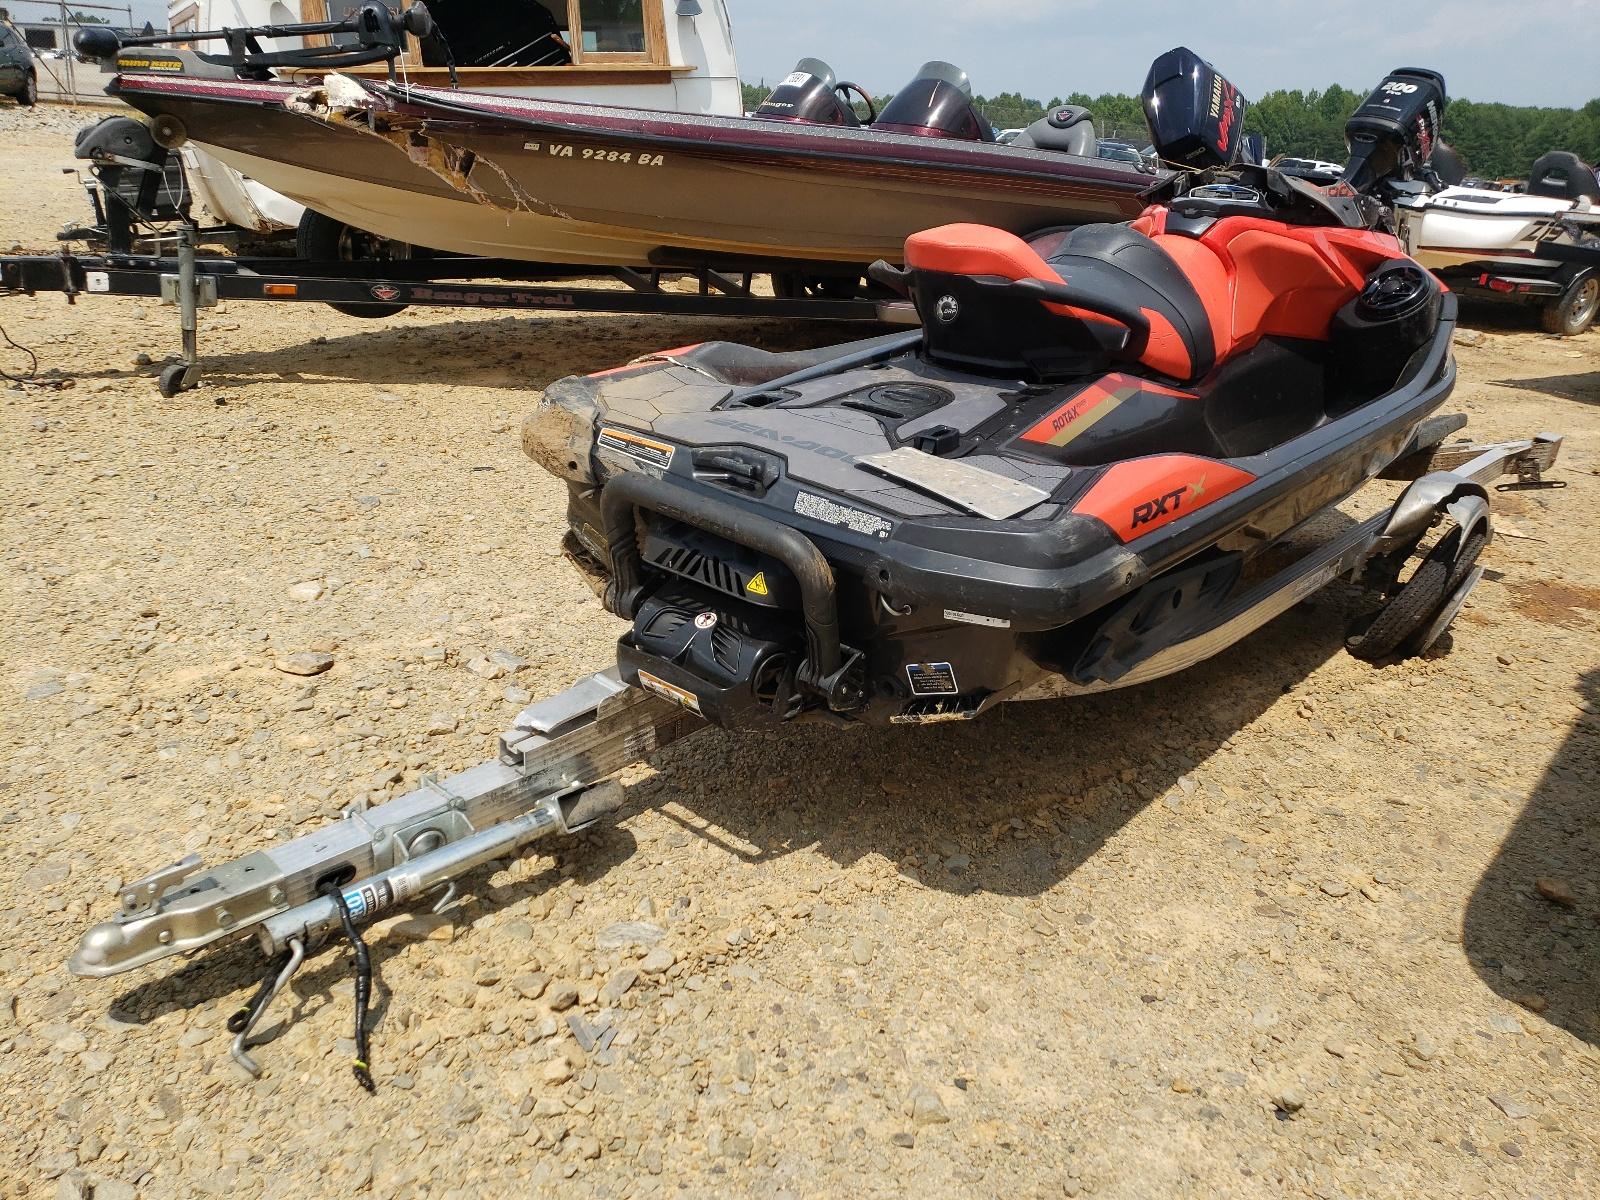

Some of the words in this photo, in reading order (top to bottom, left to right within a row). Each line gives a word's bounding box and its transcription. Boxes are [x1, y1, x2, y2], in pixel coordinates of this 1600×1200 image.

[1210, 74, 1222, 119] YAMAHA
[1380, 81, 1418, 94] 200
[549, 144, 573, 157] VA
[582, 148, 631, 163] 9284
[637, 153, 664, 166] BA
[410, 287, 509, 304] Ranger
[512, 292, 574, 305] Trail
[1052, 405, 1080, 432] ROTAX
[1130, 485, 1187, 529] RXT
